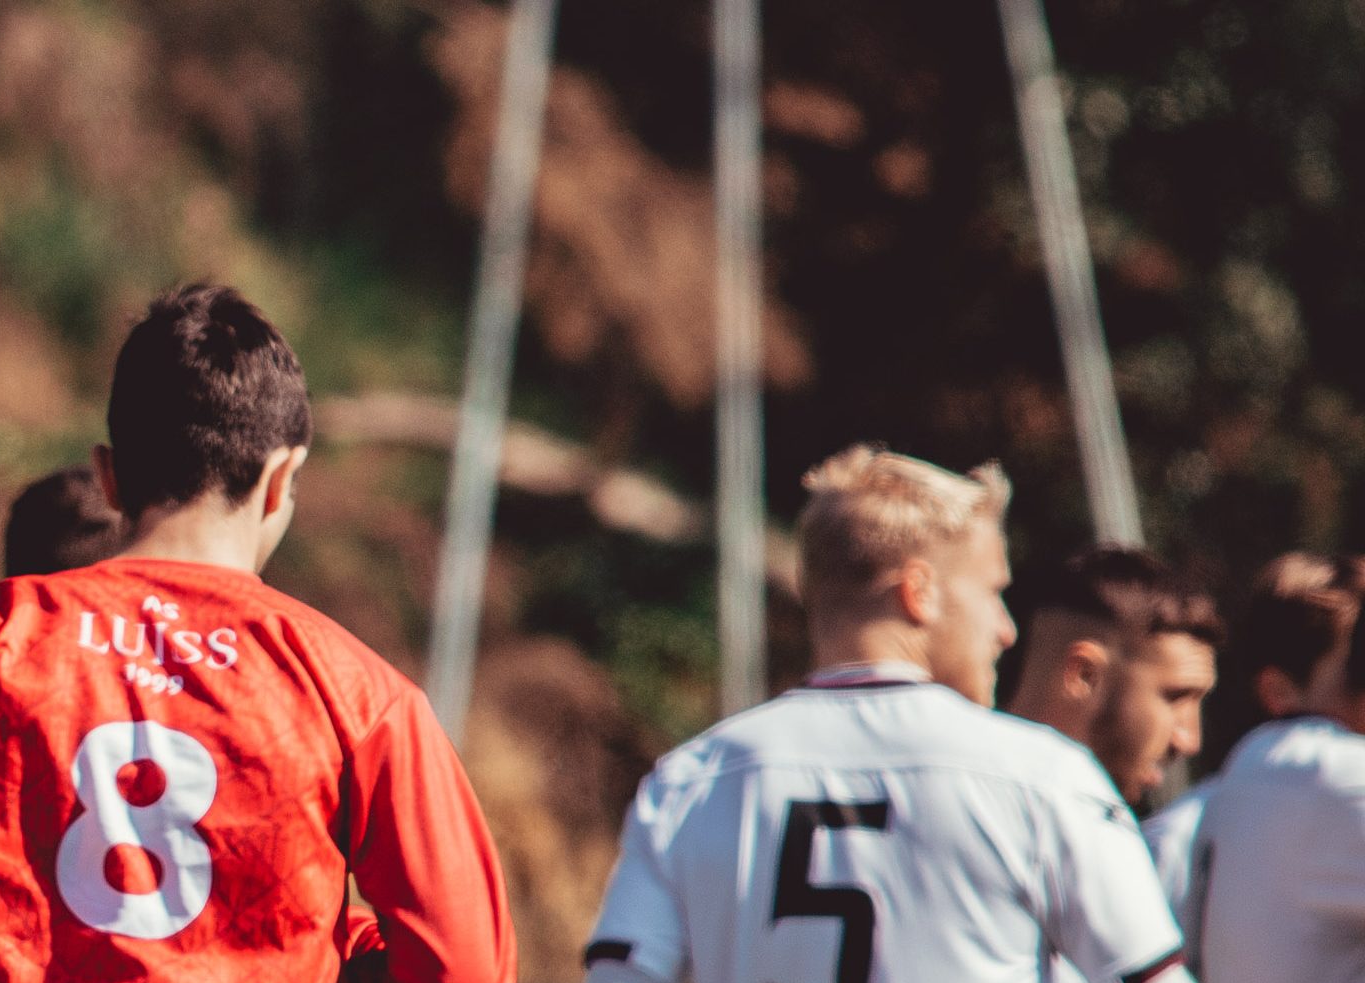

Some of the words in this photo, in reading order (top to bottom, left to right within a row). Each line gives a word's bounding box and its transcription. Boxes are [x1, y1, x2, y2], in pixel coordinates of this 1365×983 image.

[142, 595, 179, 620] AS
[77, 611, 238, 670] LUISS
[124, 662, 184, 696] 1999
[55, 720, 218, 940] 8
